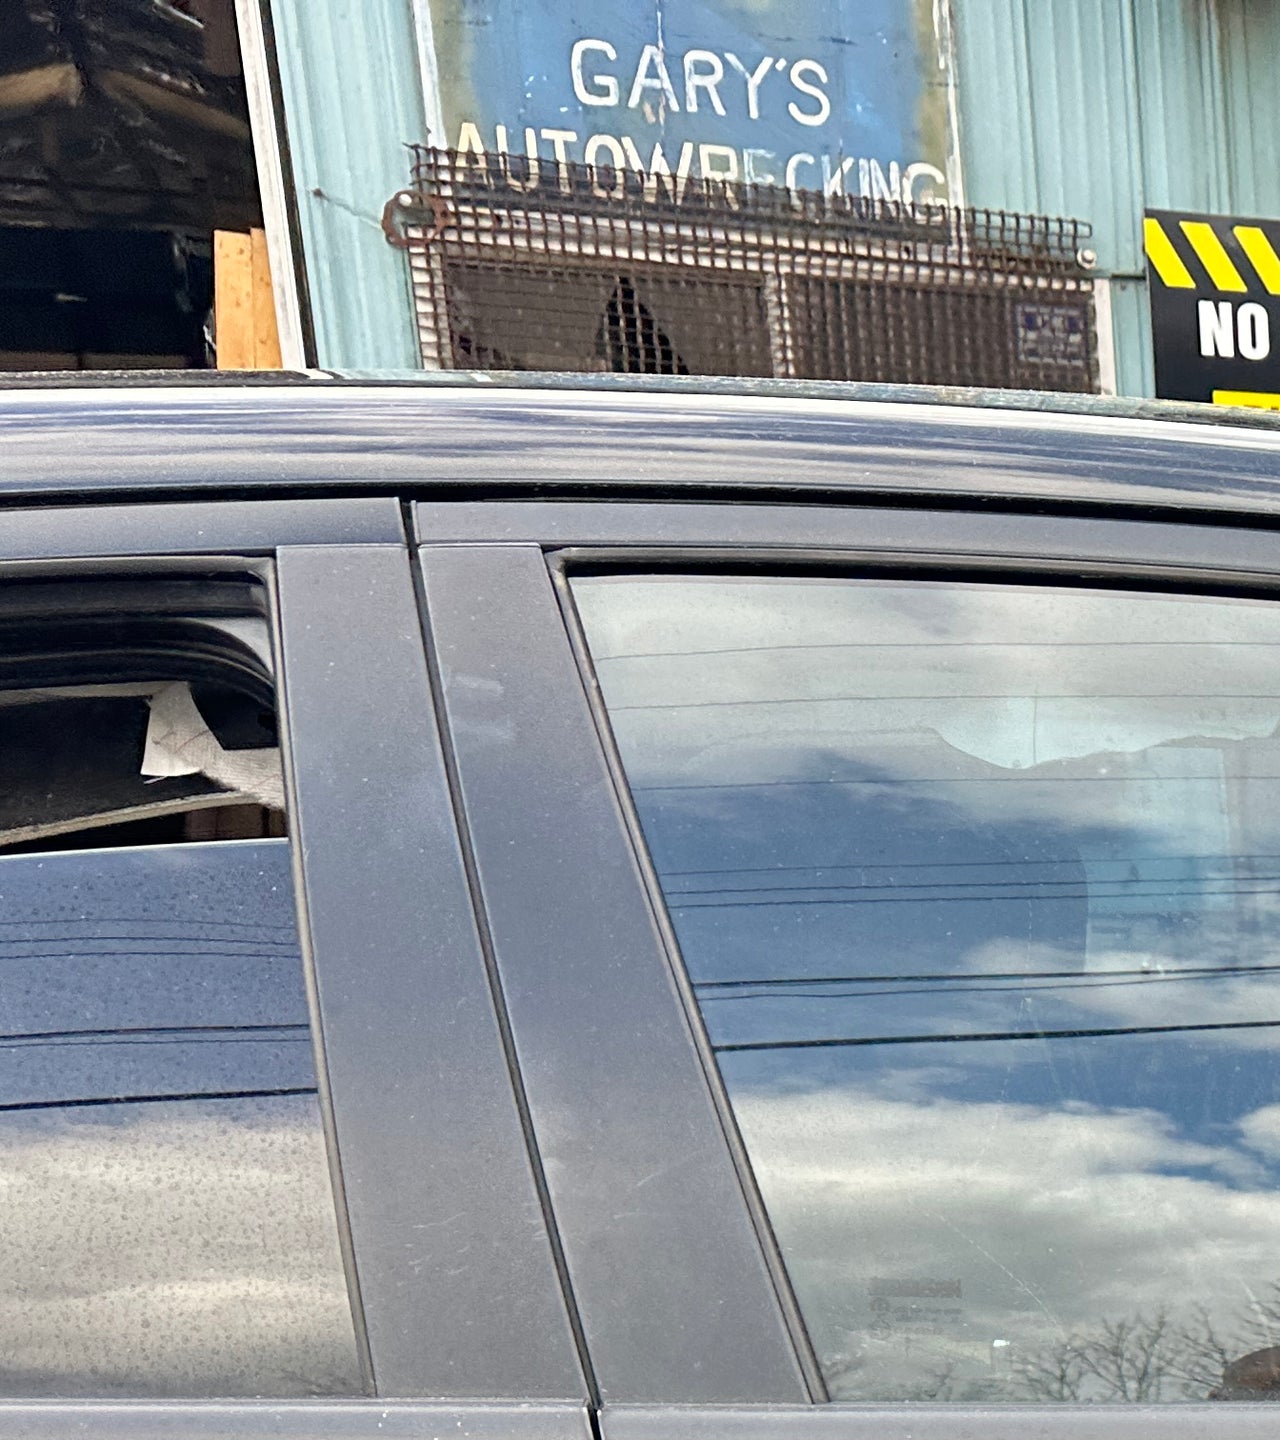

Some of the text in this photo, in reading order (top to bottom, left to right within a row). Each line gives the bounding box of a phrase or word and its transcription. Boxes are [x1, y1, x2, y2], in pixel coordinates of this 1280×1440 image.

[570, 38, 832, 127] GARY'S
[455, 122, 948, 225] AUTOWRECKING
[1198, 300, 1271, 361] NO
